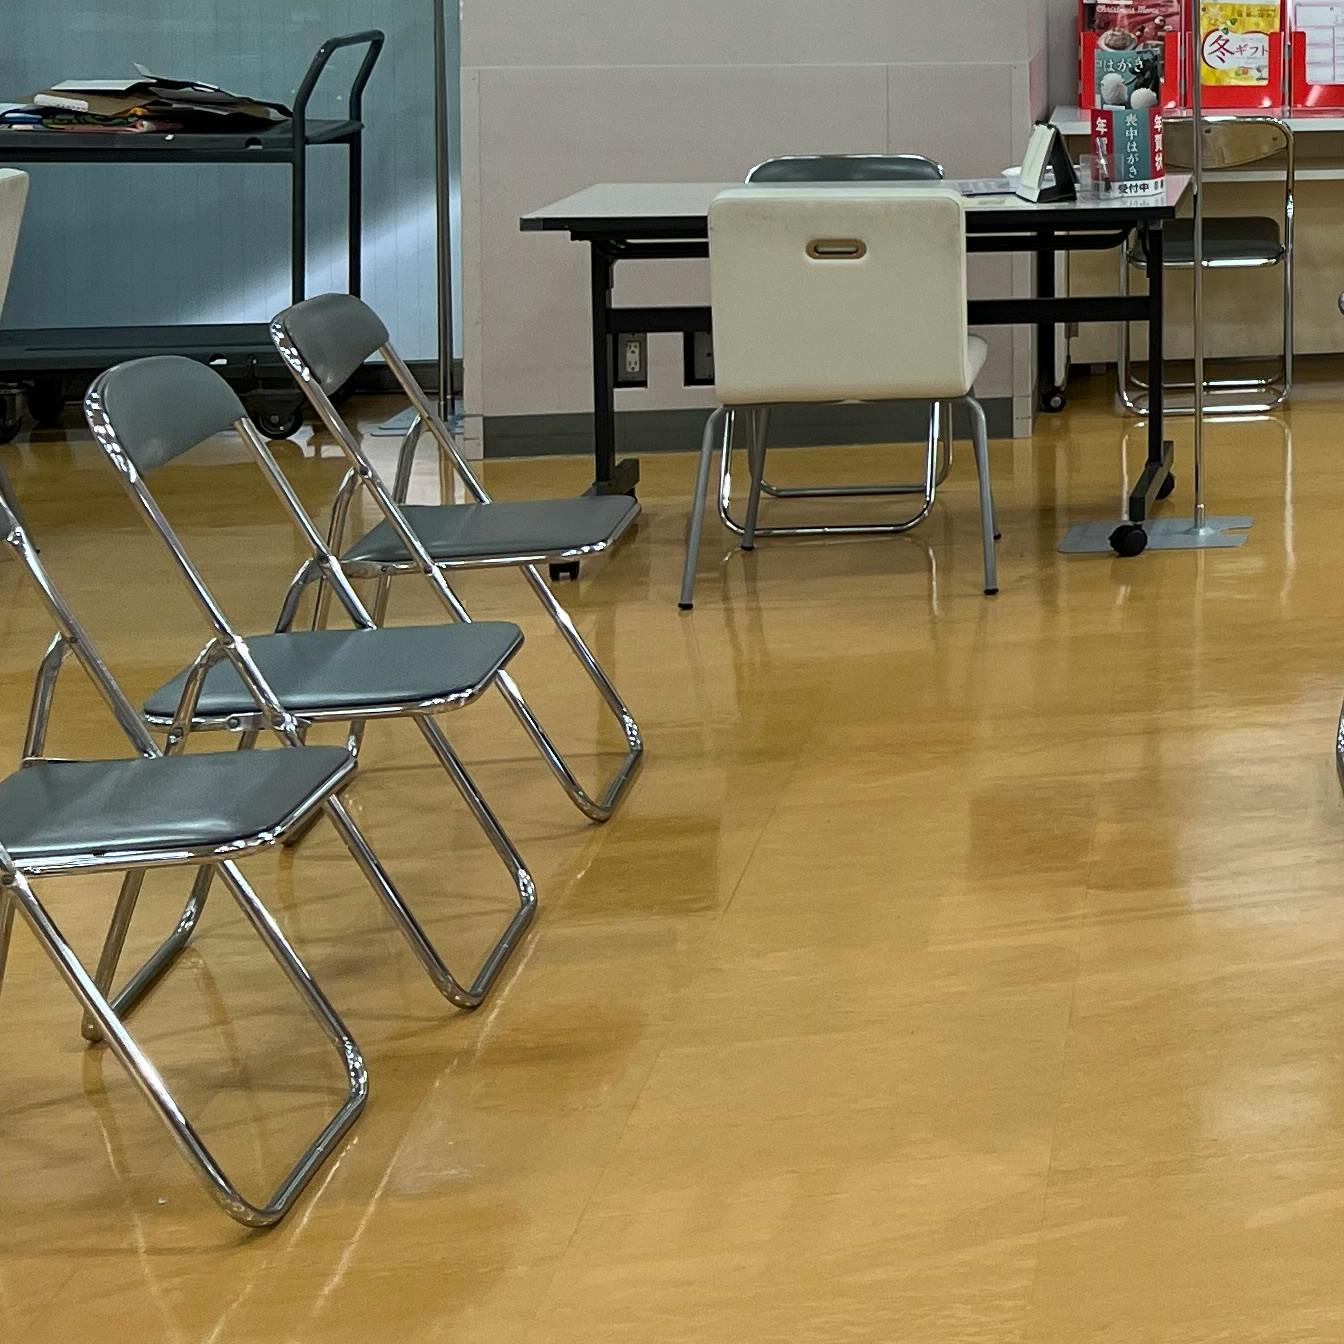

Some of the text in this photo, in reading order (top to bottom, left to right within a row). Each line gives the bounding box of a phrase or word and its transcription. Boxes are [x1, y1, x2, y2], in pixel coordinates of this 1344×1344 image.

[1103, 57, 1144, 73] はがき
[1124, 113, 1140, 179] 喪中はがき
[1118, 182, 1150, 194] 受付中
